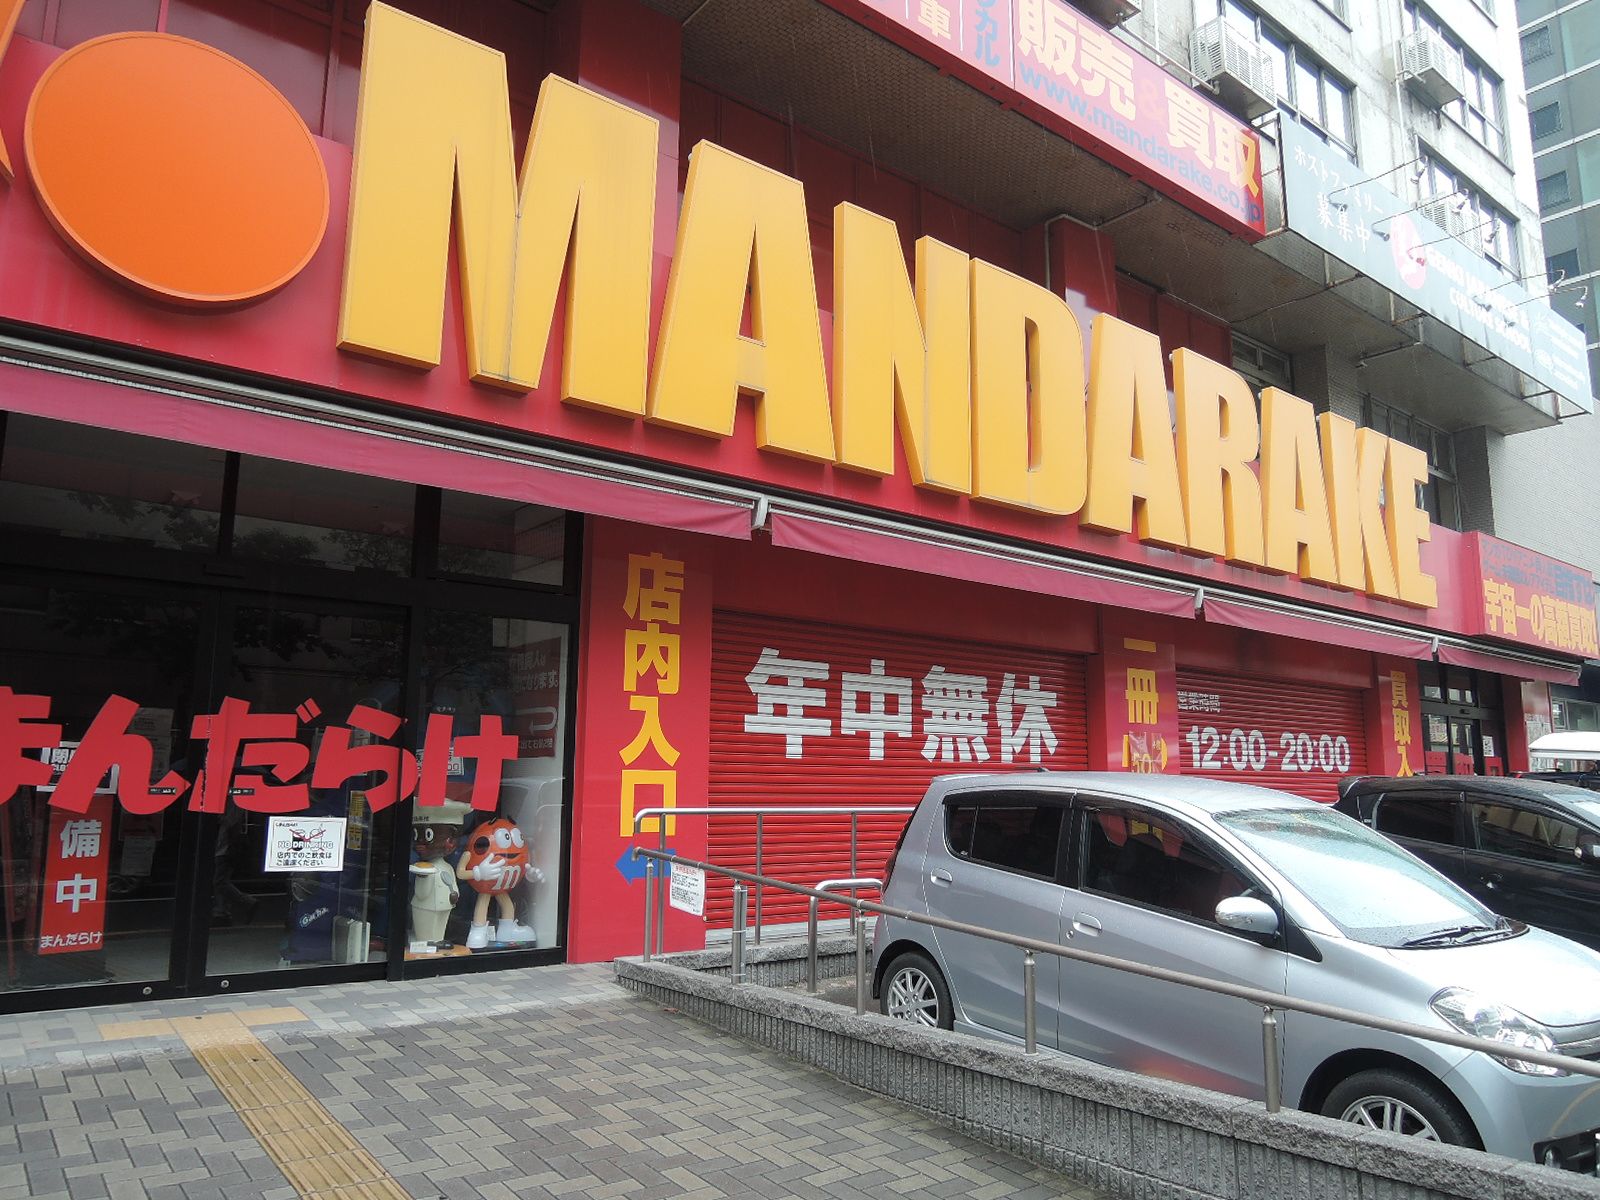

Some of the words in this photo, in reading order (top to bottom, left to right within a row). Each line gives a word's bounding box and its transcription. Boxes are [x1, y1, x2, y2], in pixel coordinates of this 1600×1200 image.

[976, 0, 999, 66] カル
[1019, 60, 1262, 224] www.mandarake.co.jp
[1316, 191, 1371, 254] 募集中
[336, 0, 1437, 609] MANDARAKE
[619, 552, 684, 837] 店内入口
[744, 647, 1058, 763] 年中無休
[1186, 725, 1350, 773] 12:00-20:00
[41, 932, 103, 949] まんだらけ
